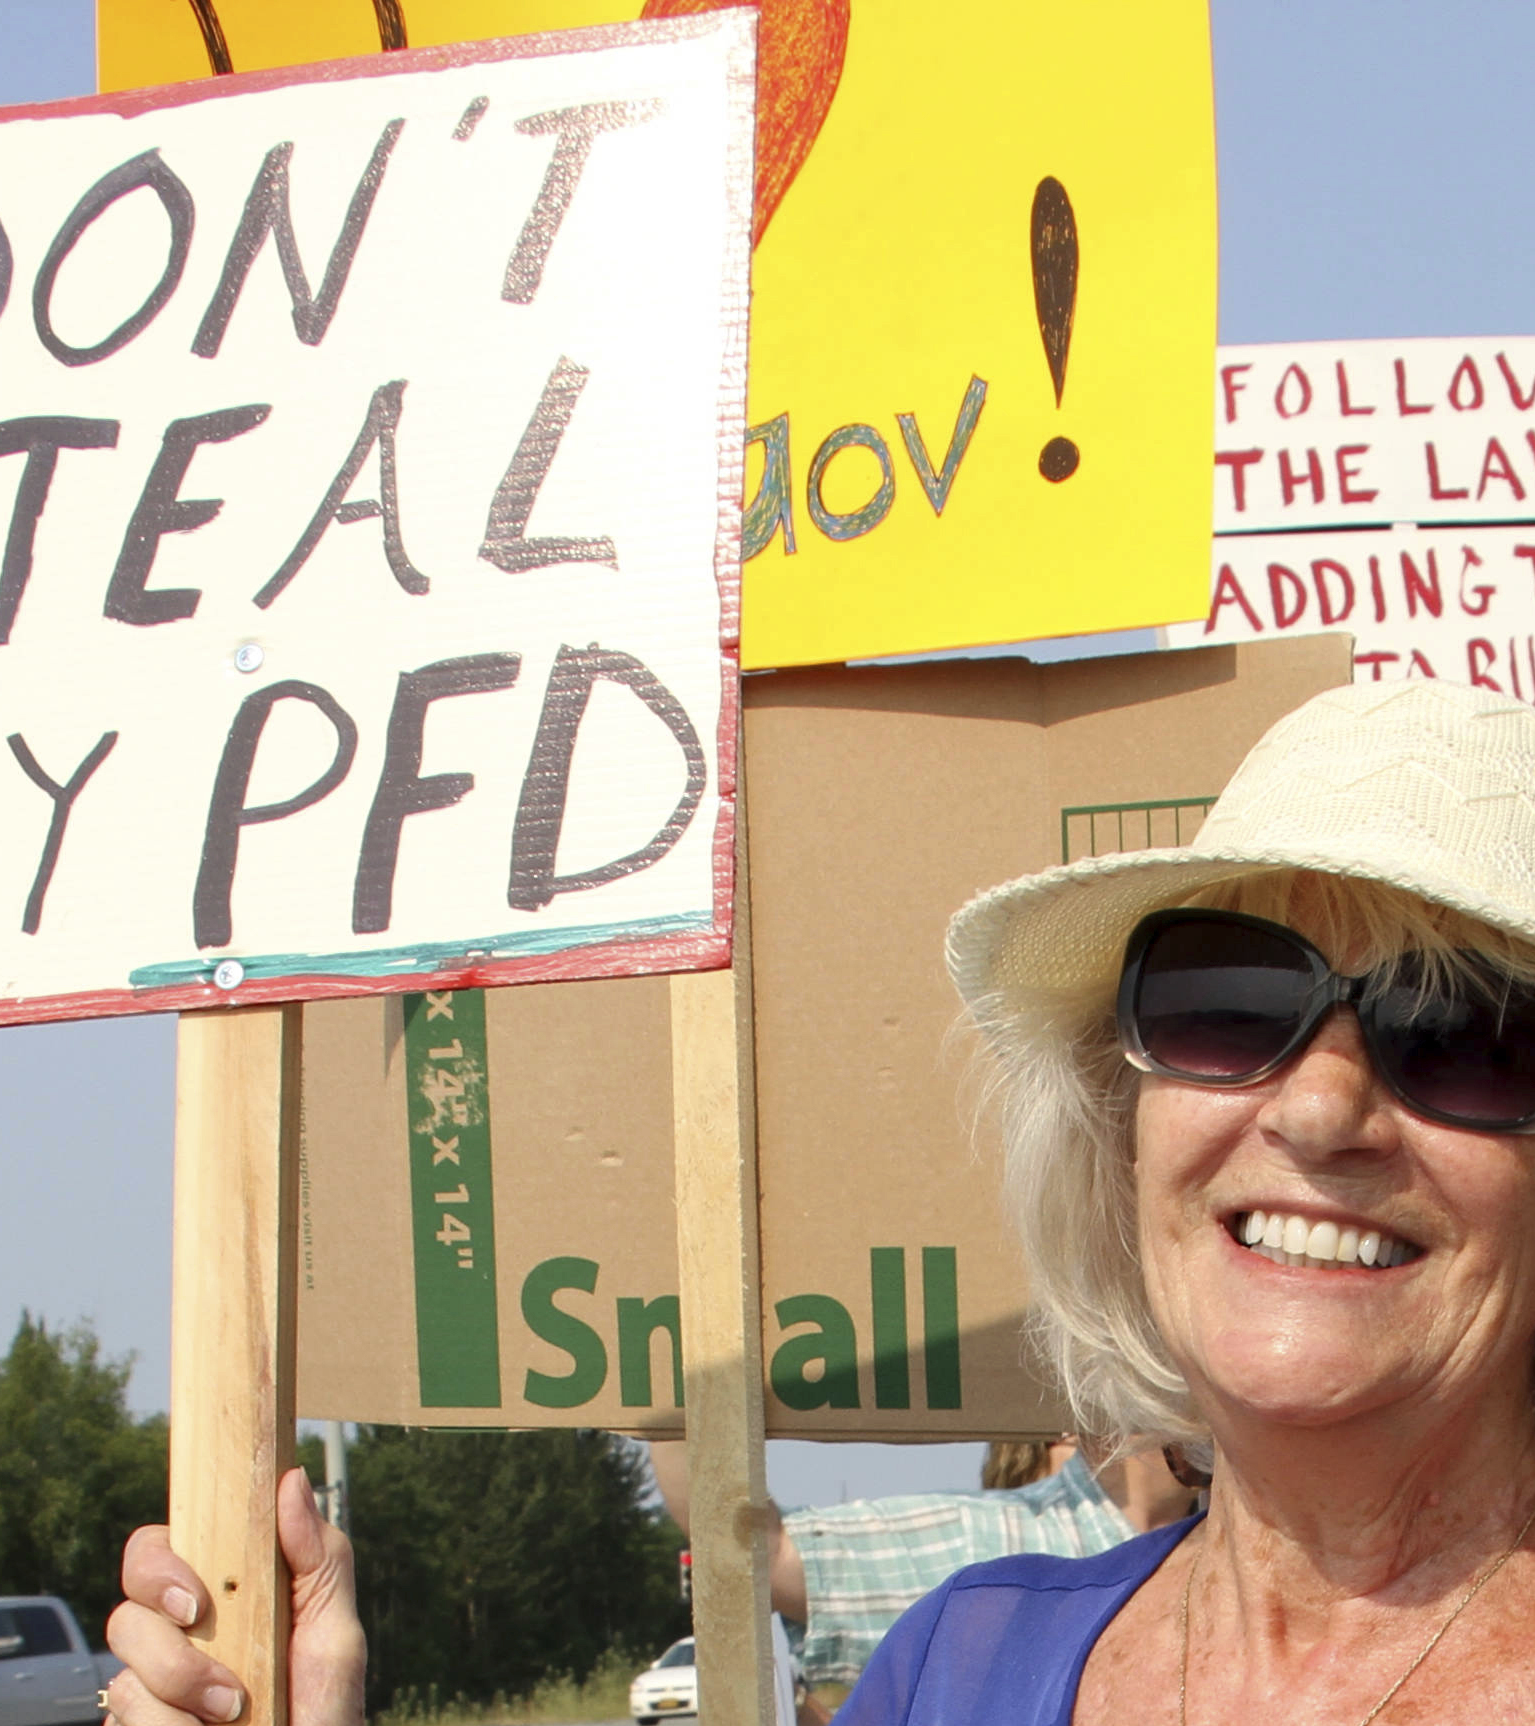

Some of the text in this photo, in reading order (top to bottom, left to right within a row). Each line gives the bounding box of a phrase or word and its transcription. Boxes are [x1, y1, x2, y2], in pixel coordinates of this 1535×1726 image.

[1214, 443, 1379, 513] THE
[1204, 545, 1497, 635] ADDING
[193, 642, 707, 949] PFD
[433, 1183, 474, 1270] 14"
